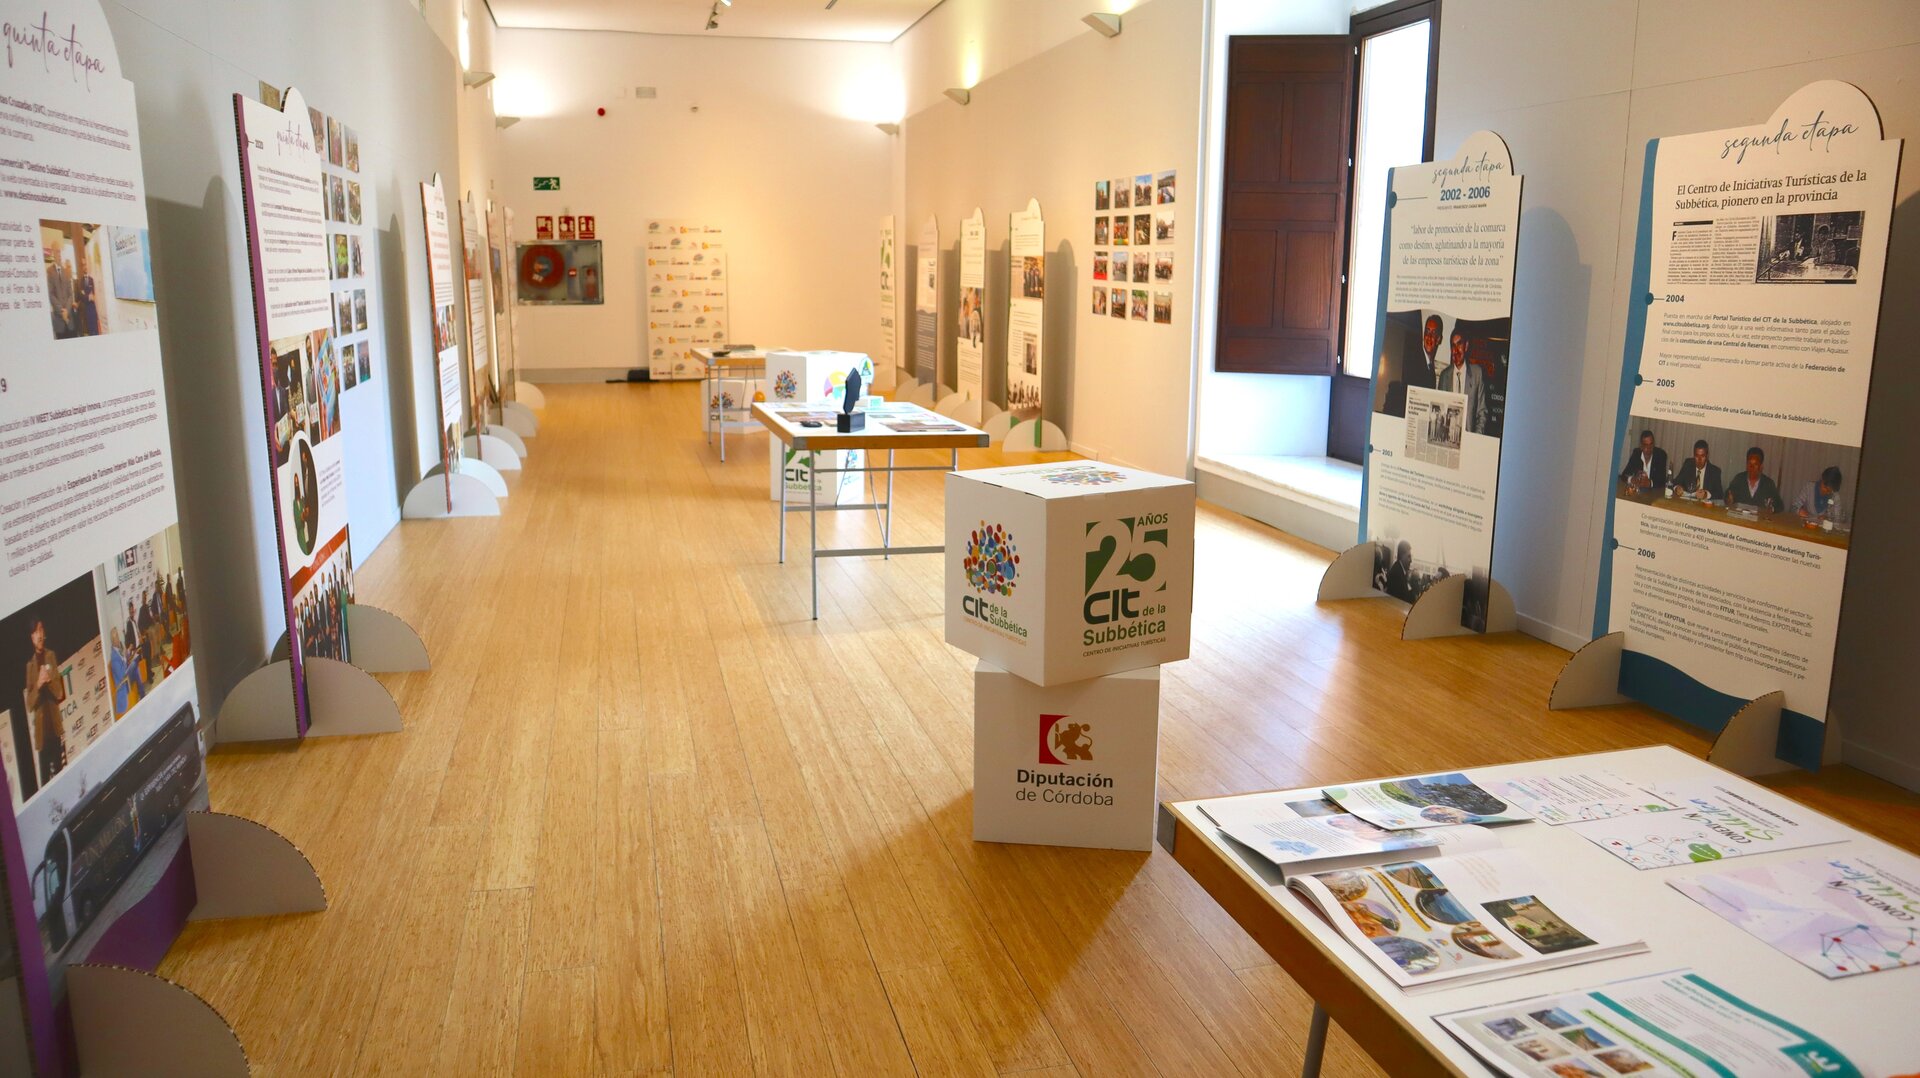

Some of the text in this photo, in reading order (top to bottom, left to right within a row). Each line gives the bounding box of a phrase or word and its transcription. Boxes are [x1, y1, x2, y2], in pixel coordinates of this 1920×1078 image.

[4, 12, 105, 92] quinta etapa
[1721, 110, 1859, 164] segunda etapa
[1432, 152, 1506, 188] segunda etapa
[1677, 170, 1867, 195] El Centro de Iniciativas Turísticas de la
[1440, 188, 1461, 201] 2002
[1468, 186, 1490, 199] 2006
[1675, 189, 1838, 212] Subbética, pionero en la provincia
[1427, 224, 1434, 233] de
[1435, 224, 1464, 236] promoción
[1465, 223, 1472, 232] de
[1474, 223, 1479, 232] la
[1414, 240, 1434, 251] destino,
[1435, 240, 1467, 251] aglutinando
[1473, 240, 1478, 248] la
[1480, 239, 1504, 250] mayoría
[1403, 255, 1409, 264] de
[1418, 258, 1442, 267] empresas
[1443, 256, 1468, 265] turísticas
[1469, 256, 1476, 265] de
[1478, 256, 1483, 265] la
[1666, 294, 1685, 303] 2004
[1805, 364, 1836, 372] Federación
[1656, 379, 1675, 388] 2005
[1684, 402, 1722, 412] comercialización
[1752, 410, 1773, 418] Turística
[1788, 414, 1815, 423] Subbética
[1137, 513, 1168, 527] AÑOS
[1684, 523, 1706, 535] Congreso
[1707, 528, 1728, 539] Nacional
[1736, 535, 1772, 549] Comunicación
[1777, 545, 1805, 558] Marketing
[1085, 517, 1168, 597] 25
[1637, 548, 1656, 560] 2006
[1770, 553, 1790, 562] conocer
[990, 602, 1008, 618] de la
[1143, 604, 1166, 616] de la
[990, 614, 1027, 637] Subbética
[1083, 620, 1166, 646] Subbética
[1083, 648, 1103, 657] CENTRO
[1112, 642, 1139, 652] INICIATIVAS
[1016, 769, 1113, 788] Diputación
[1016, 788, 1113, 806] de Córdoba
